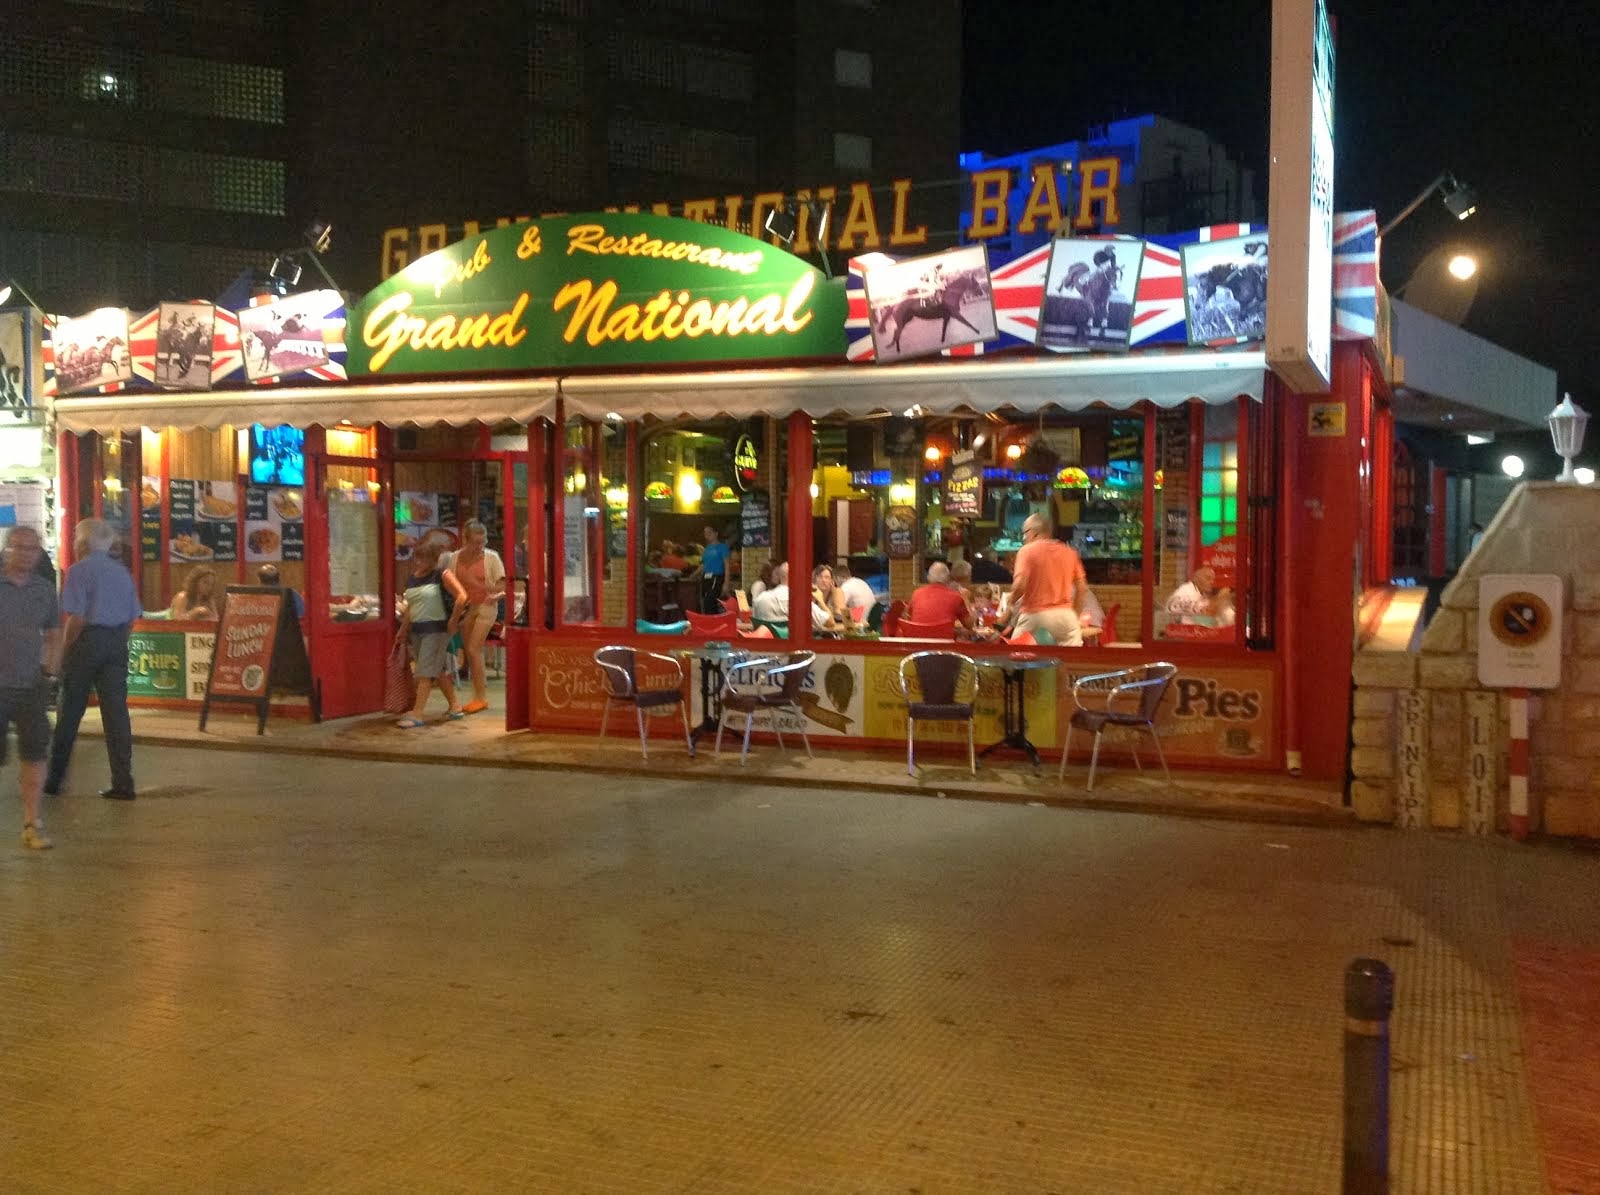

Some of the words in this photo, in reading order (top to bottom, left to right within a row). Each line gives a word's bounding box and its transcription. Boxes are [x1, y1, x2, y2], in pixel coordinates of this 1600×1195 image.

[604, 178, 928, 254] TIONAL
[966, 156, 1122, 240] BAR
[516, 224, 542, 260] &
[565, 224, 763, 275] Restaurant
[363, 291, 530, 372] Grand
[552, 270, 816, 346] National
[226, 638, 264, 658] LUNCH
[710, 665, 815, 690] ELICIOS
[1173, 677, 1261, 720] Pies
